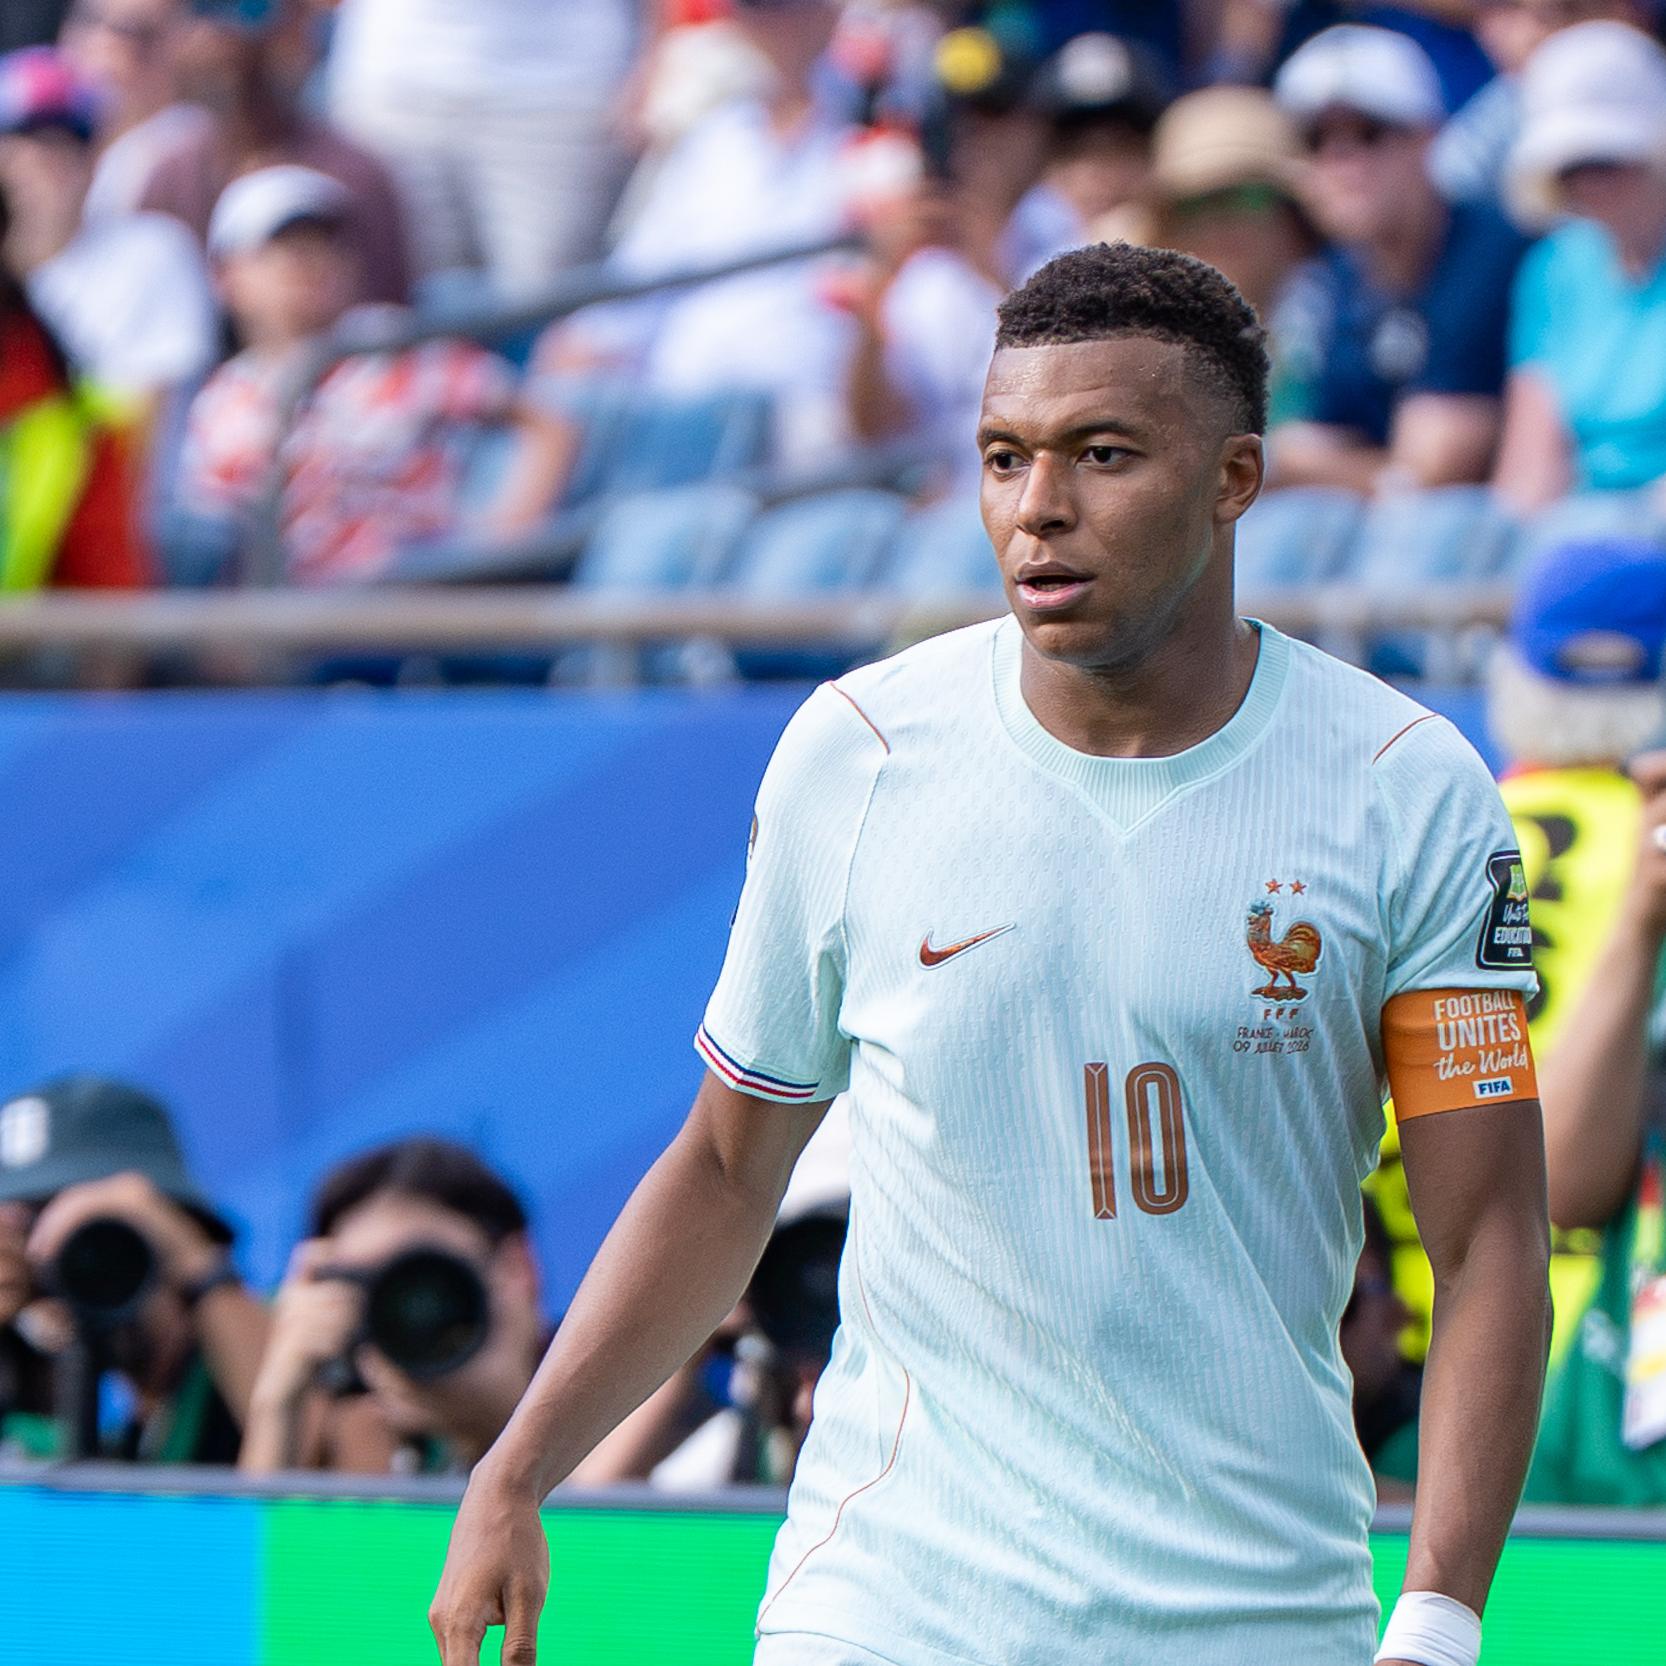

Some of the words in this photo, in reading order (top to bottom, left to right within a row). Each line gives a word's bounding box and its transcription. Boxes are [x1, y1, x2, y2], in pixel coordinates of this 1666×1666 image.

[1434, 990, 1516, 1021] FOOTBALL
[1233, 1040, 1251, 1053] 09
[1437, 1012, 1522, 1051] UNITES
[1433, 1052, 1476, 1080] the
[1478, 1042, 1529, 1075] World
[1477, 1080, 1511, 1095] FIFA
[1084, 1061, 1189, 1220] 10
